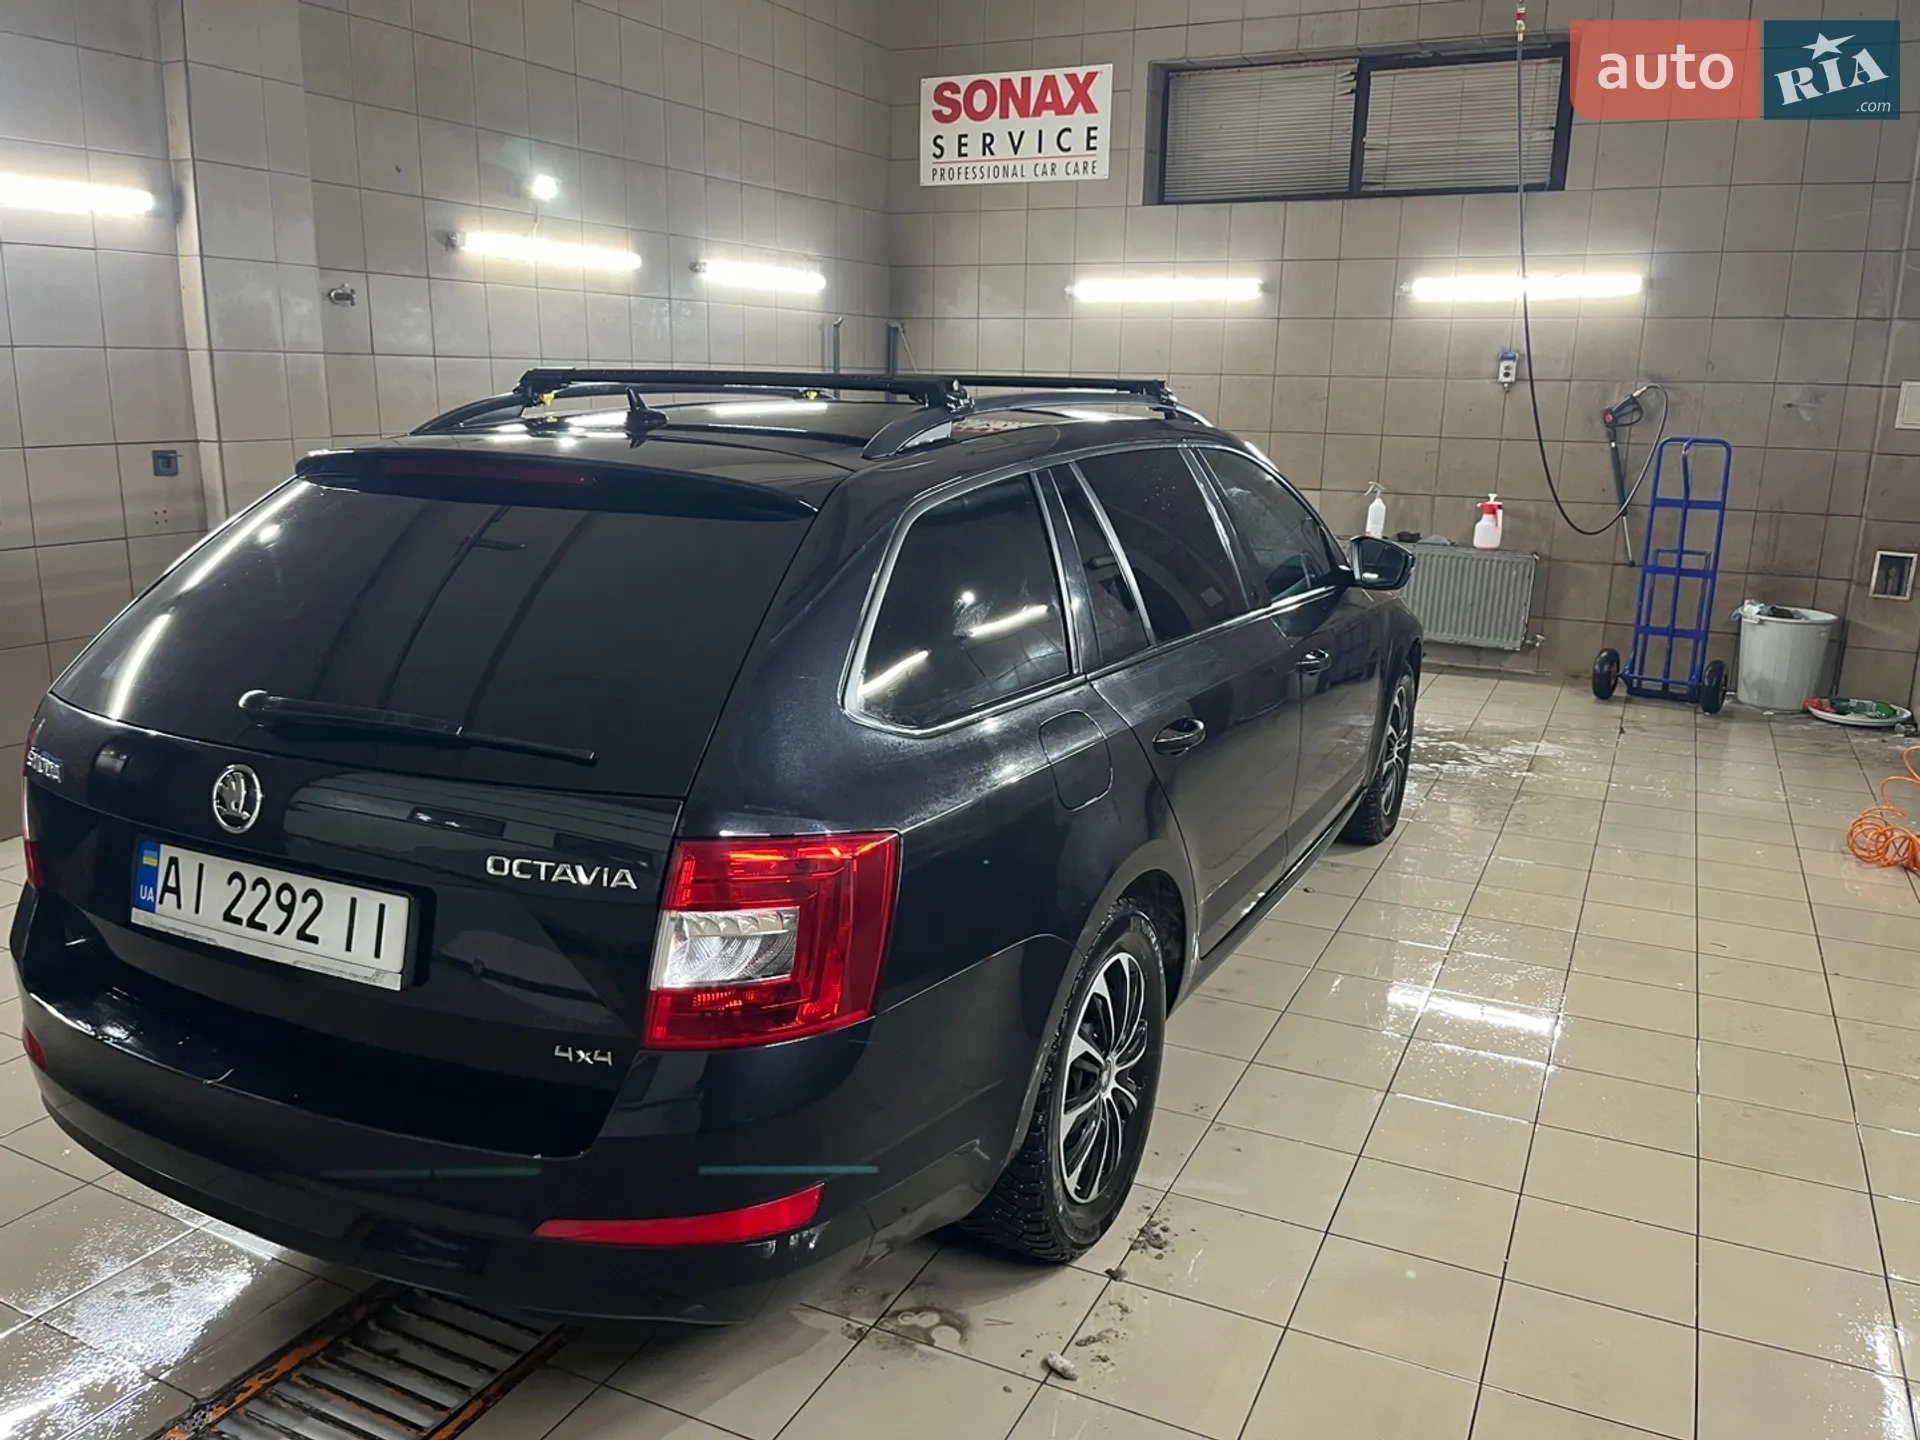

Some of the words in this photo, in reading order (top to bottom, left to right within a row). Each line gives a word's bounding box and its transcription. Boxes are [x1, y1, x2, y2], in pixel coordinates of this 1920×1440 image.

[932, 71, 1100, 124] SONAX
[932, 126, 1099, 160] SERVICE
[932, 164, 1026, 182] PROFESSIONAL
[1033, 162, 1057, 178] CAR
[1065, 160, 1098, 176] CARE
[485, 854, 638, 890] OCTAVIA
[139, 884, 155, 903] UA
[158, 855, 205, 915] AI
[222, 870, 324, 945] 2292
[345, 896, 387, 960] II
